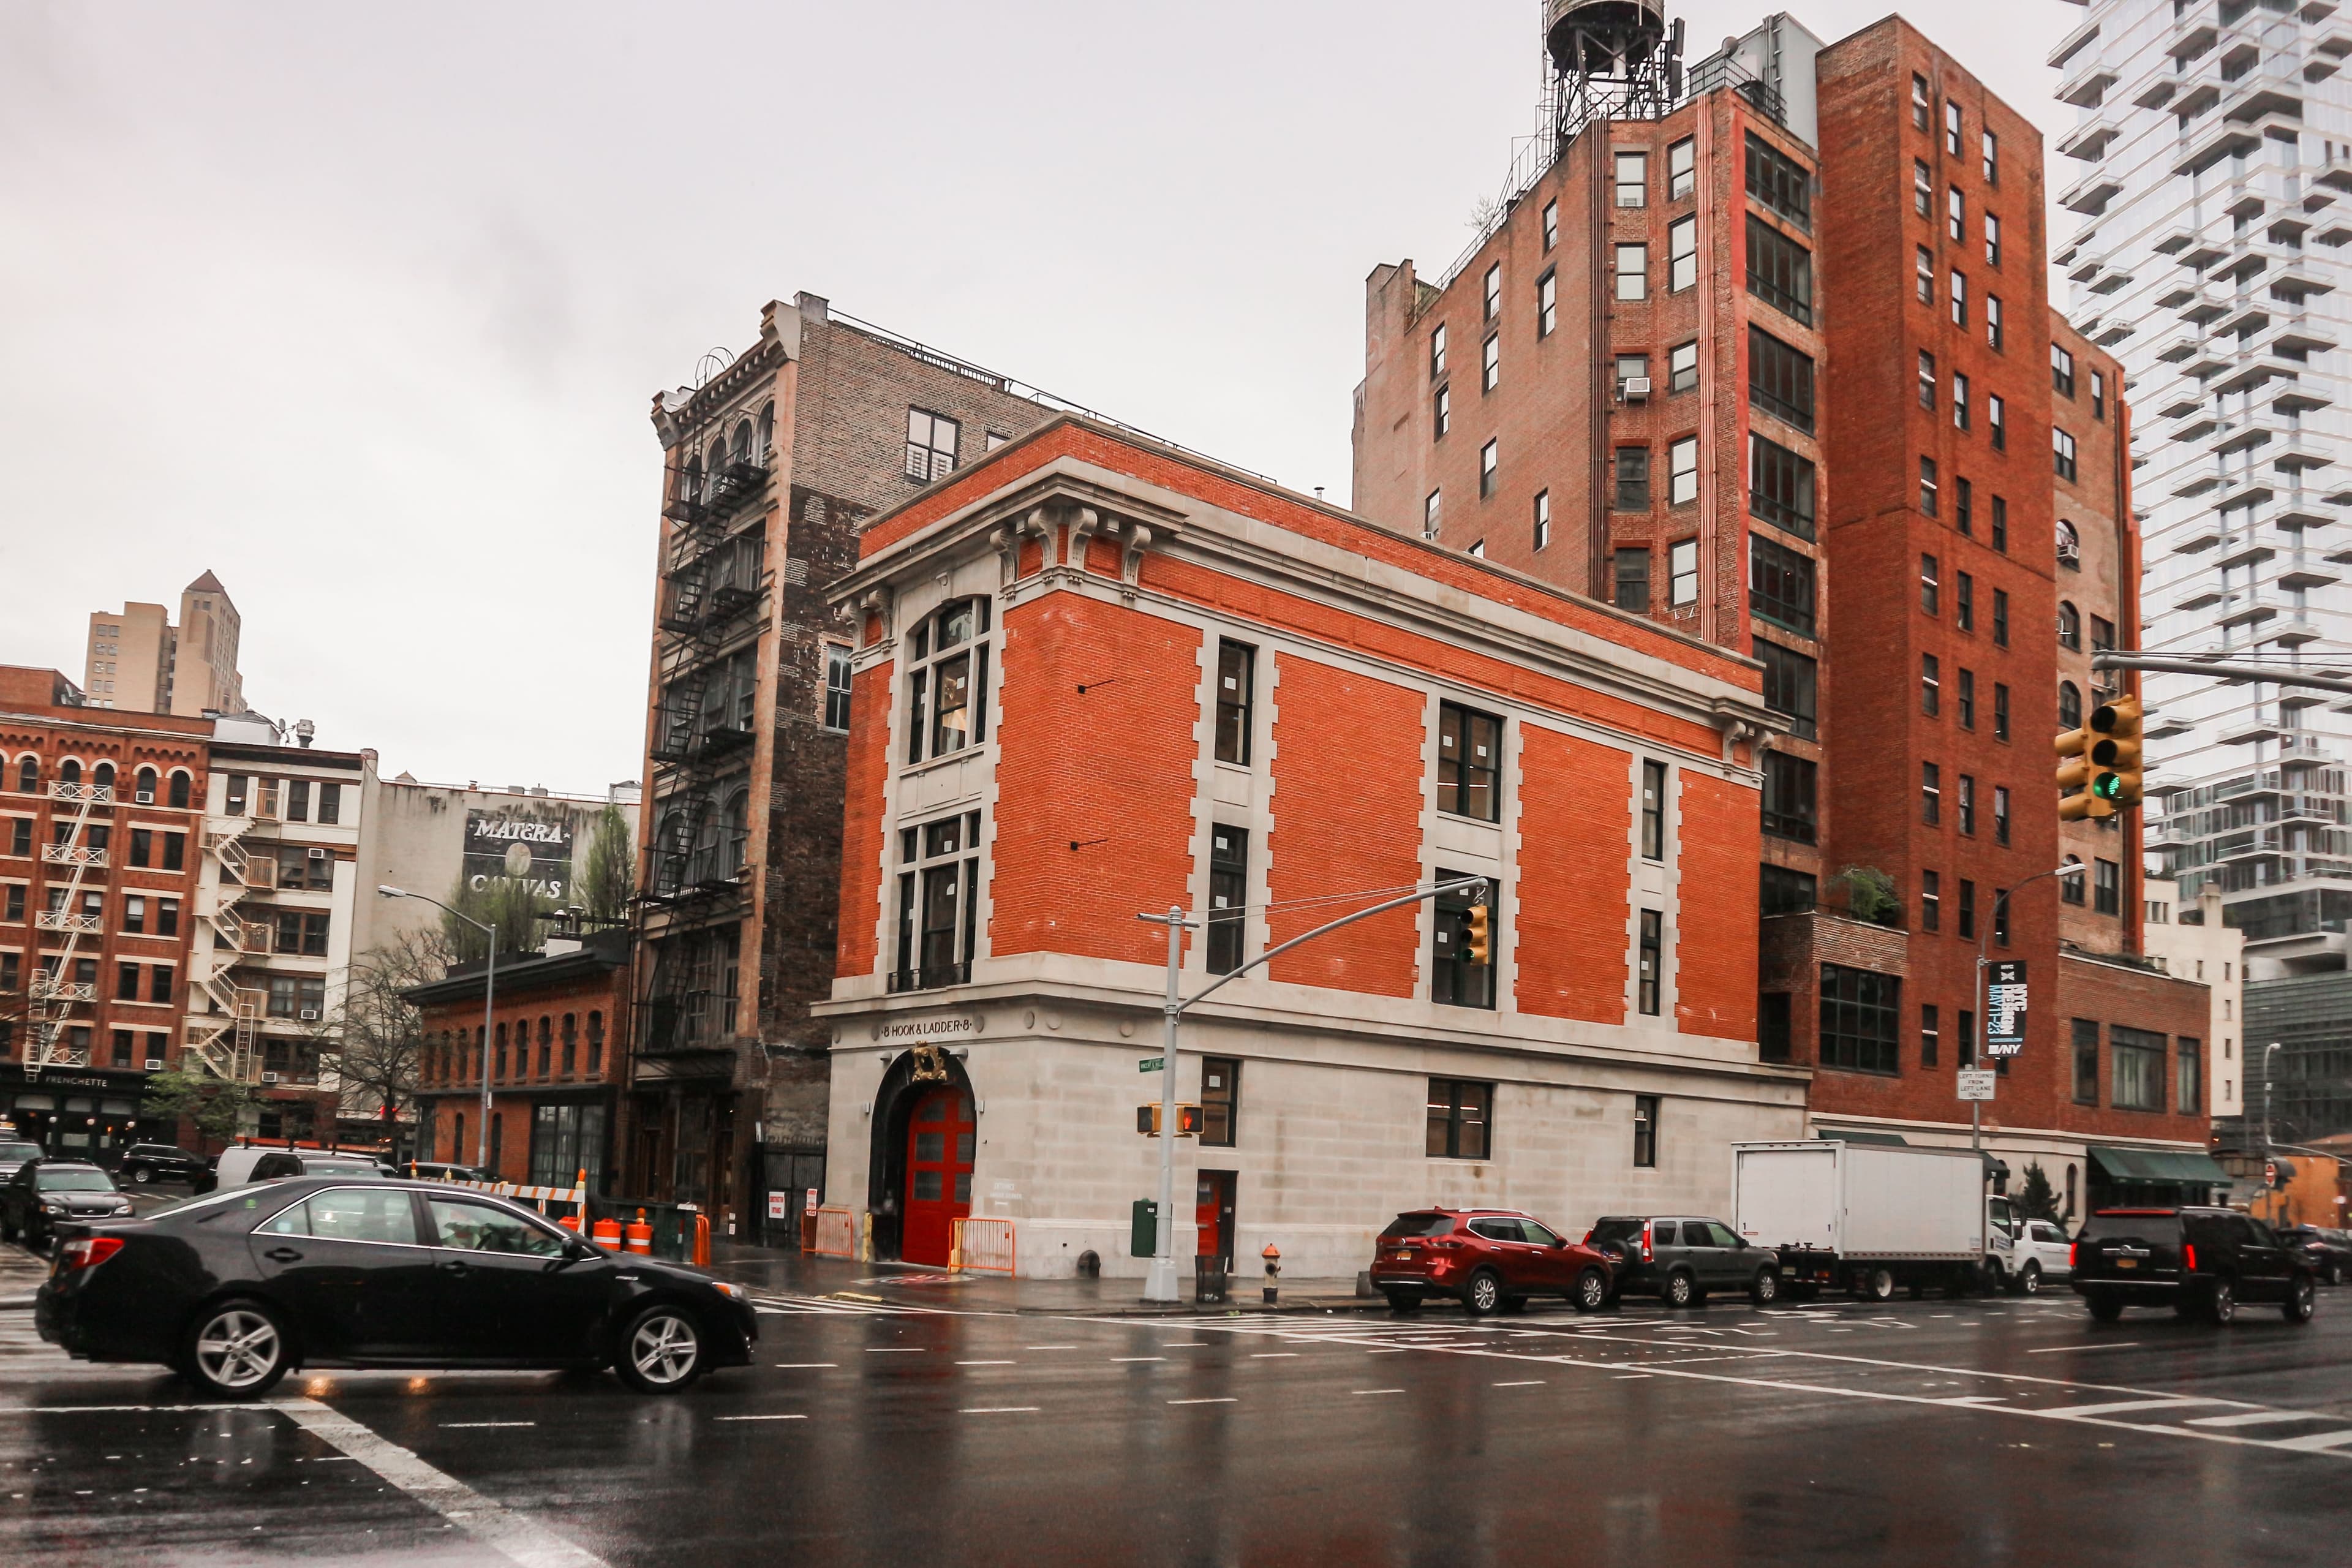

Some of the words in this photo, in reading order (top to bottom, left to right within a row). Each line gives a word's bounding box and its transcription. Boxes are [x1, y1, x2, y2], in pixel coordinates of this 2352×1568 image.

[473, 819, 563, 843] MATERA
[470, 874, 562, 899] CVAS
[1989, 985, 2002, 1006] MAY
[2014, 984, 2027, 1011] NYC
[892, 1024, 915, 1036] HOOK
[916, 1023, 922, 1035] &
[924, 1020, 960, 1034] LADDER
[45, 1075, 108, 1087] FRENCHETTE
